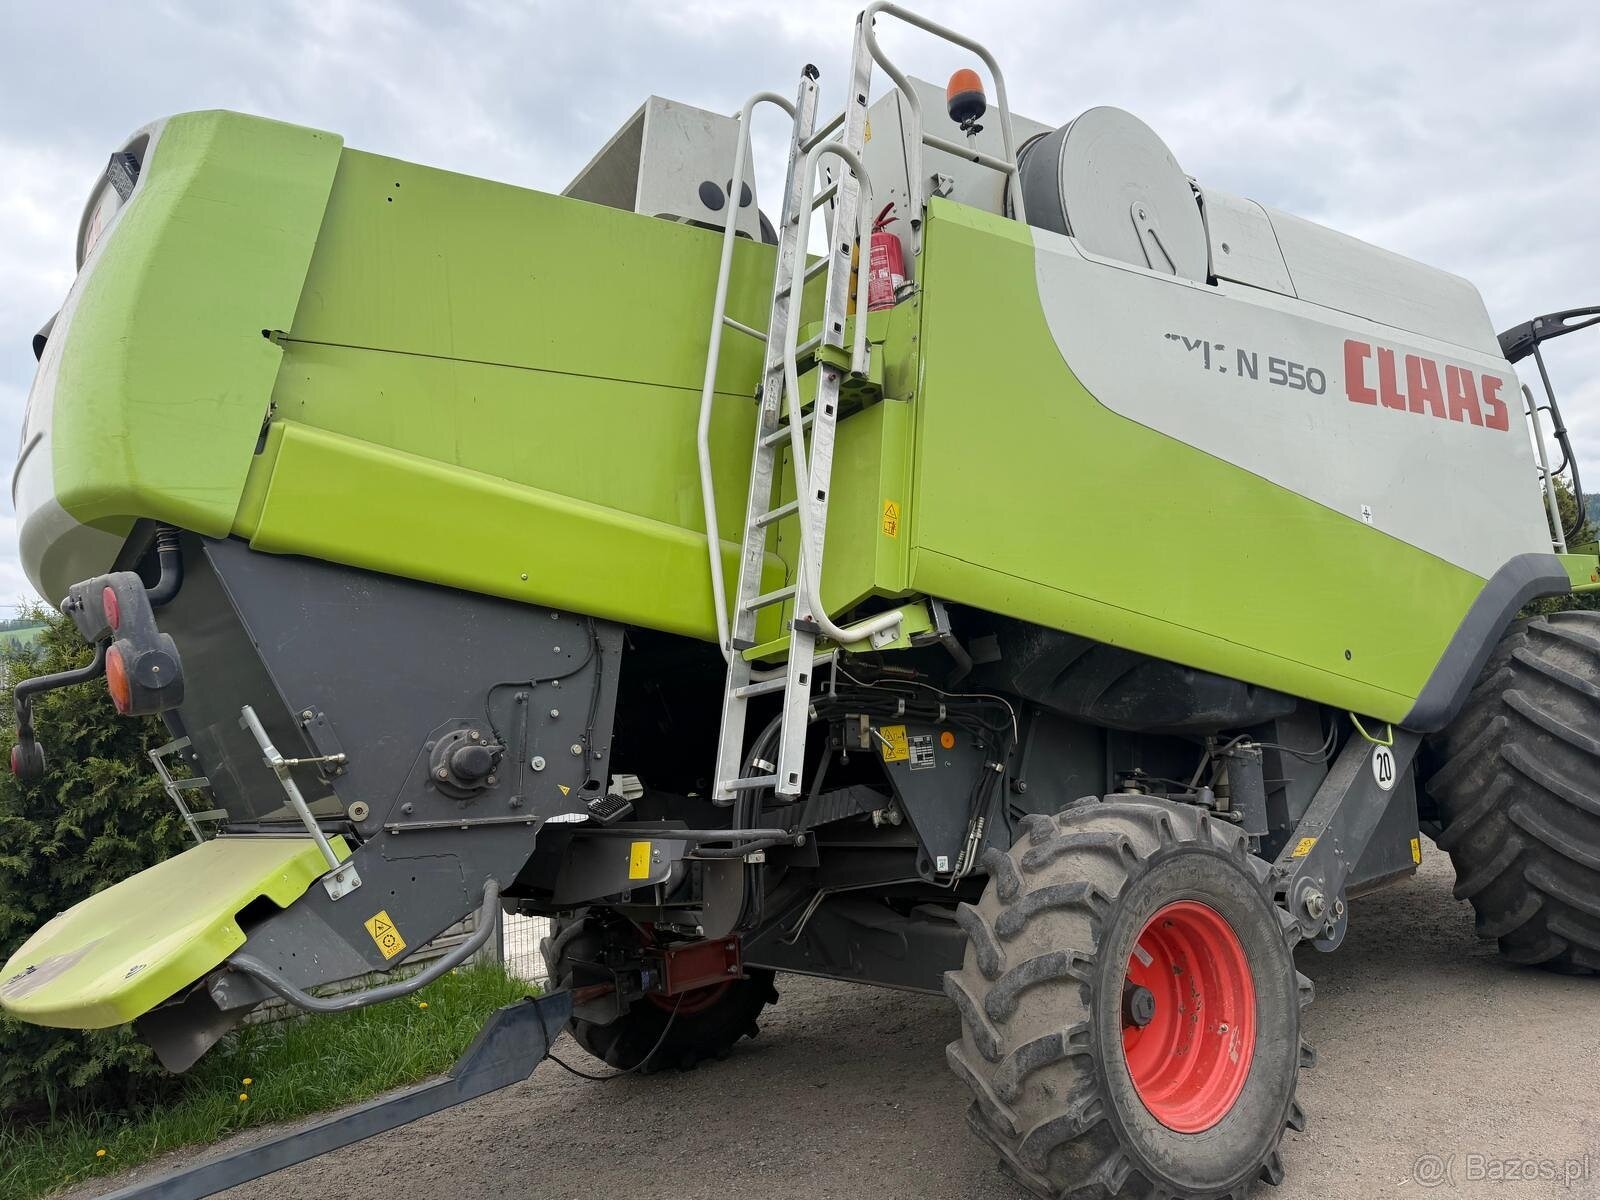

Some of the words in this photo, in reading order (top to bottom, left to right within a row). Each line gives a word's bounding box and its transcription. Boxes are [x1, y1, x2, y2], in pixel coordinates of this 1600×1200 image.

[1268, 356, 1327, 395] 550
[1344, 339, 1509, 432] CLAAS
[1376, 752, 1392, 781] 20
[386, 943, 401, 956] STOP
